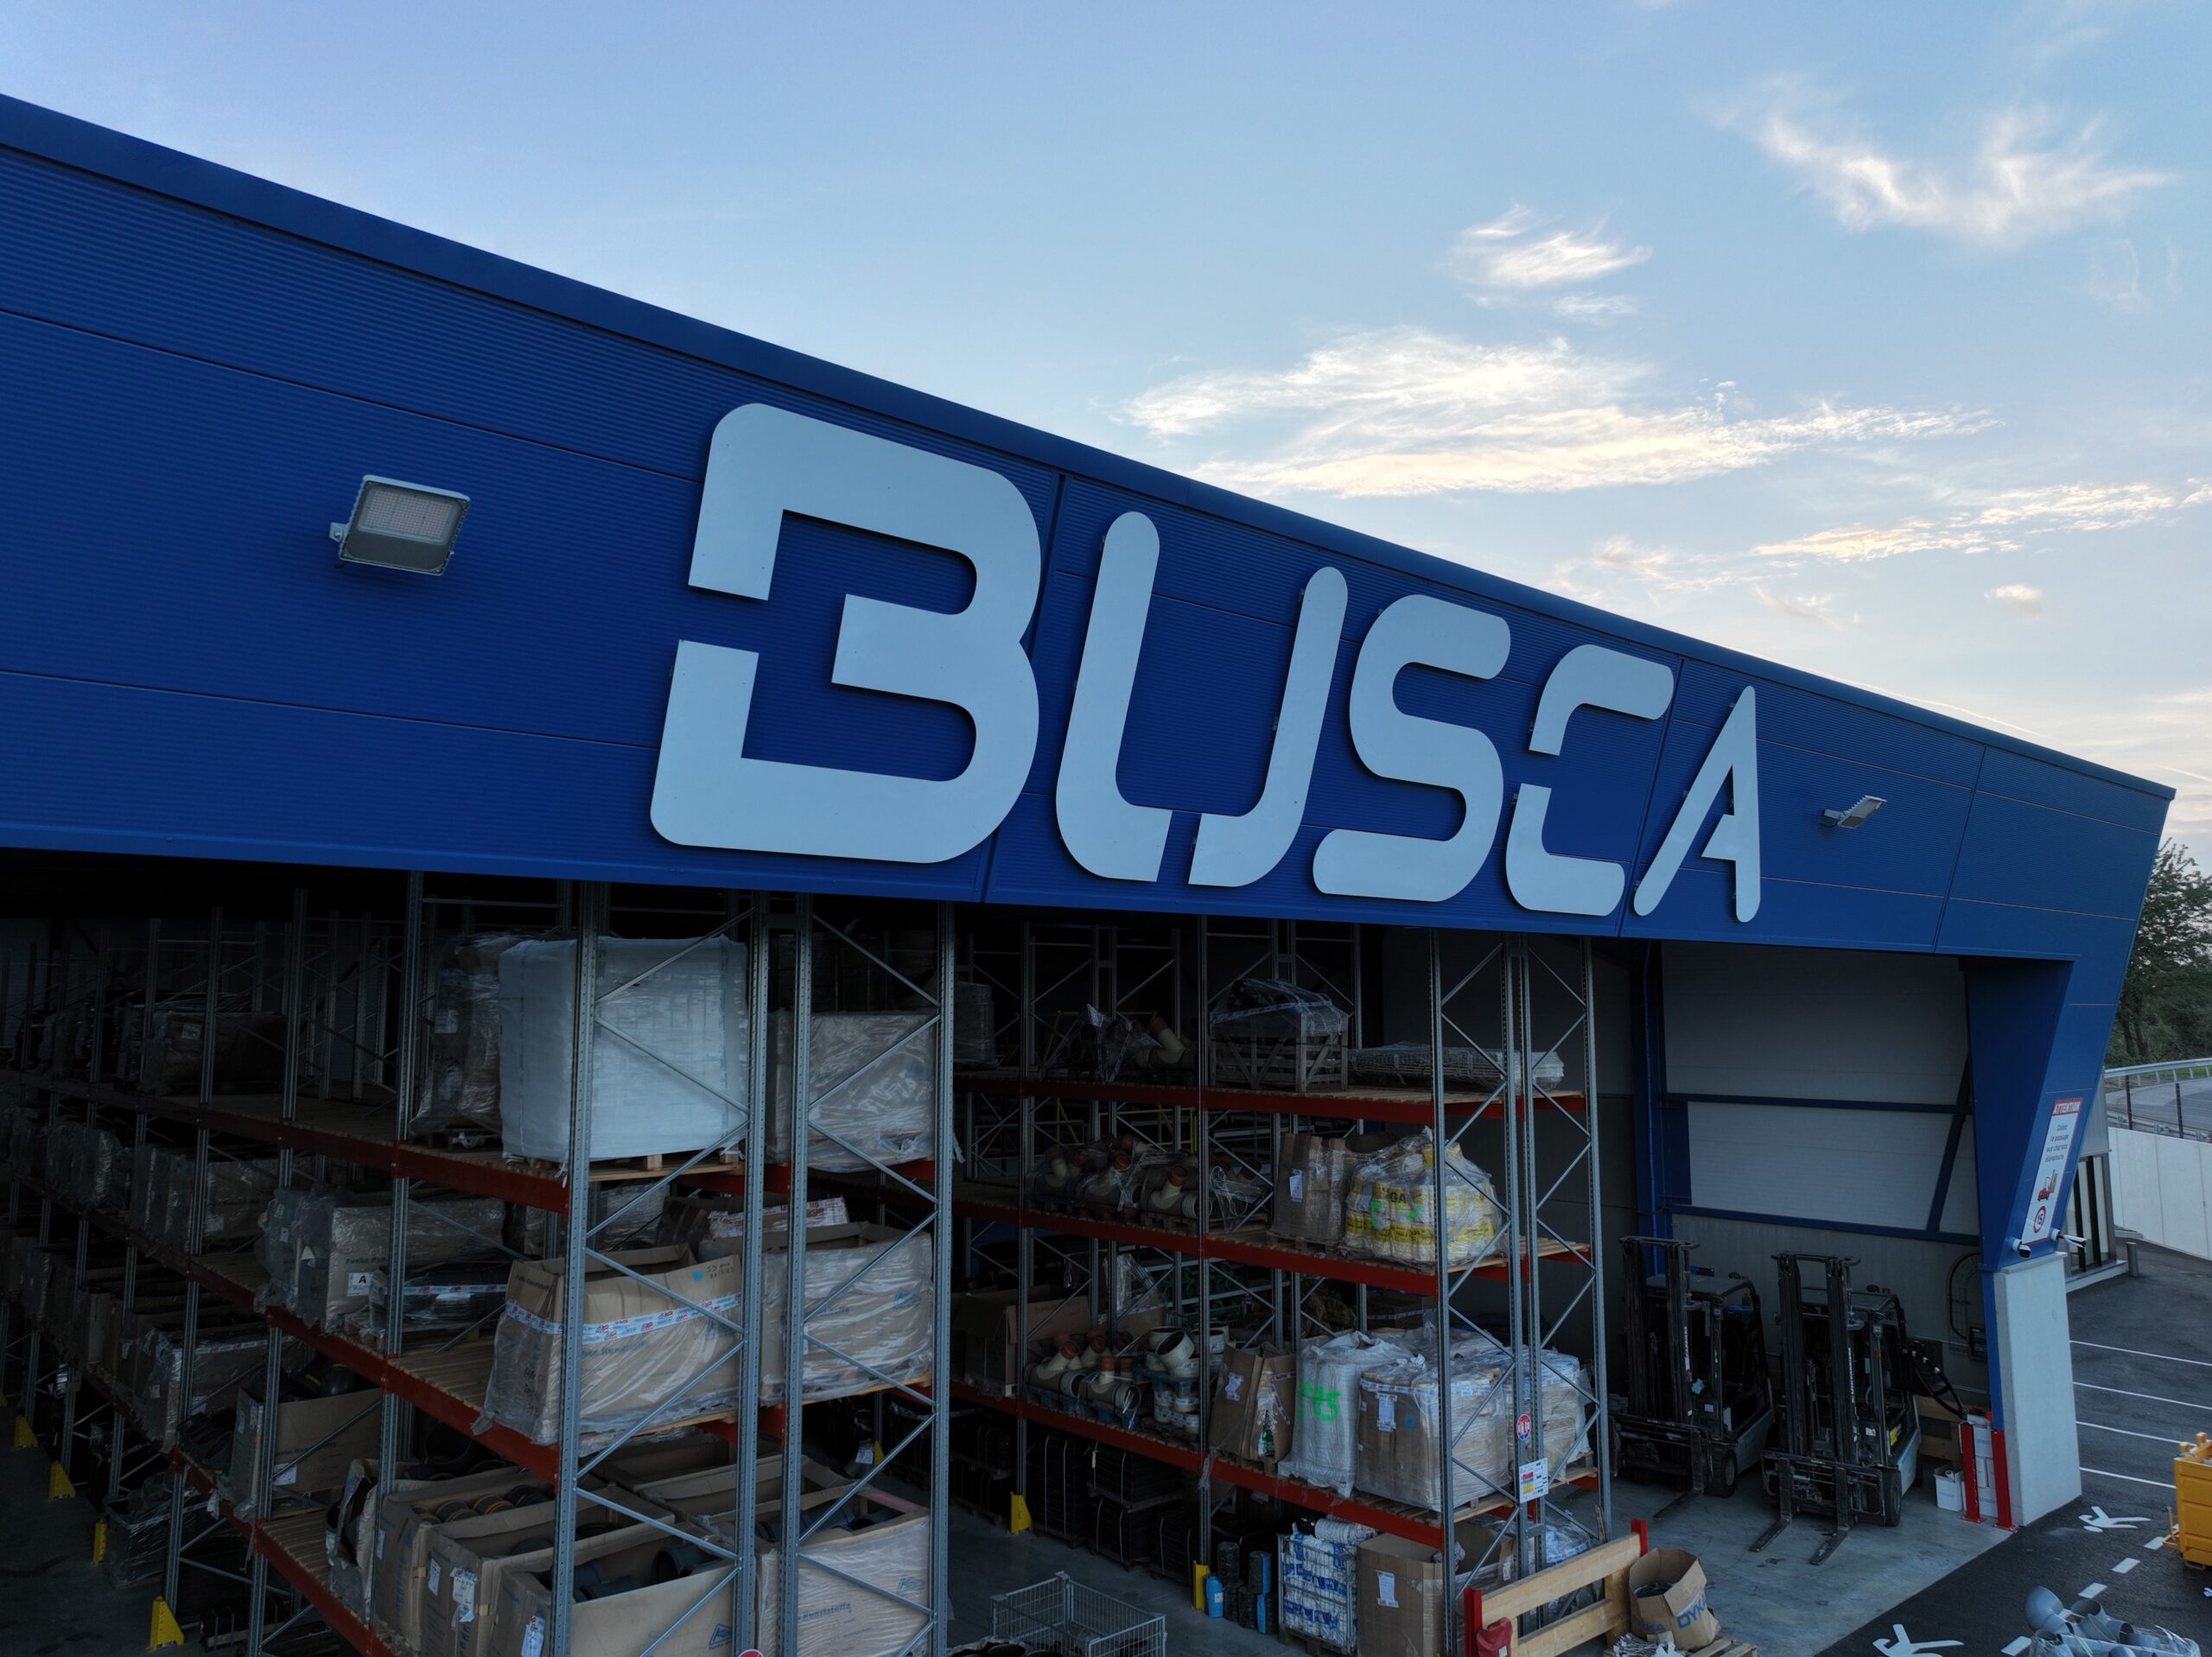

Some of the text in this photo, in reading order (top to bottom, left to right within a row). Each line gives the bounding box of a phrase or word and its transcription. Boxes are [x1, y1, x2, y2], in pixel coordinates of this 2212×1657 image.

[650, 403, 1762, 924] BUSCA
[2052, 1101, 2081, 1114] ATTENTION
[359, 1275, 366, 1284] A
[1677, 1600, 1706, 1629] DYK
